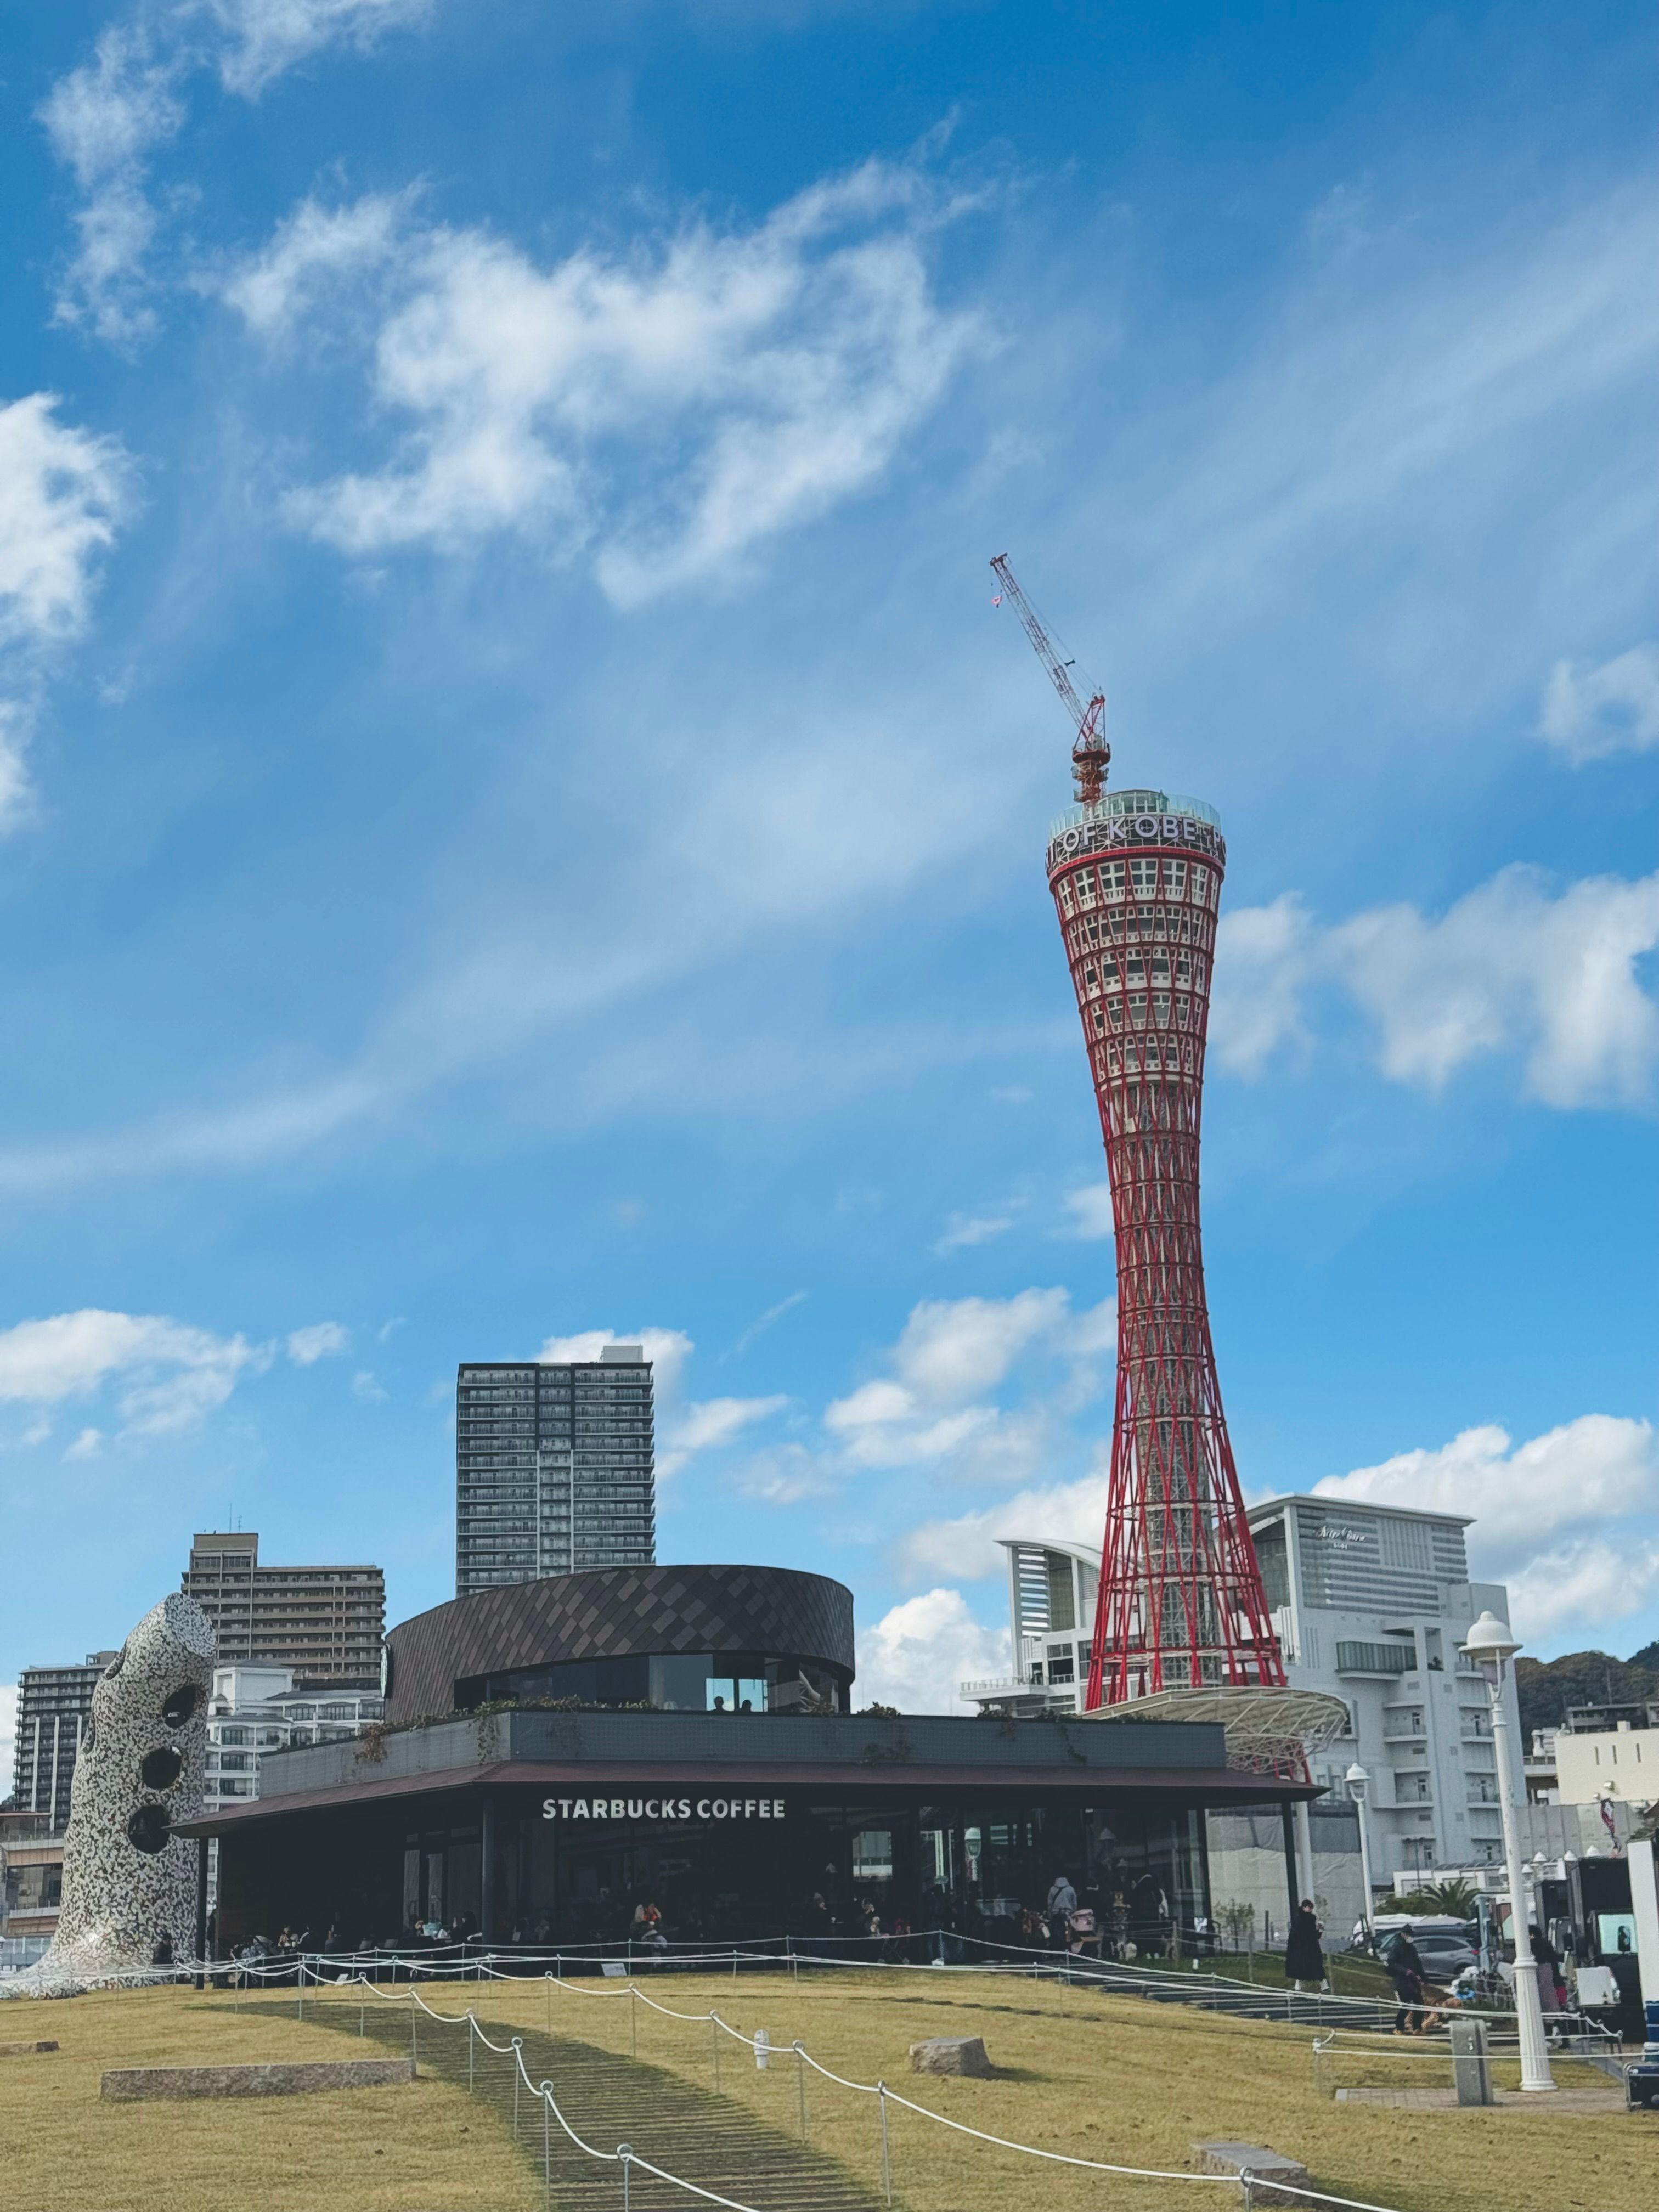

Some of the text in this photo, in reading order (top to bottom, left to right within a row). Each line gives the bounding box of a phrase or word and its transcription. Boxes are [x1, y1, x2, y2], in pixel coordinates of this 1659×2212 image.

[1063, 822, 1096, 851] OF
[1109, 815, 1195, 840] KOBE
[543, 1799, 785, 1819] STARBUCKS COFFEE
